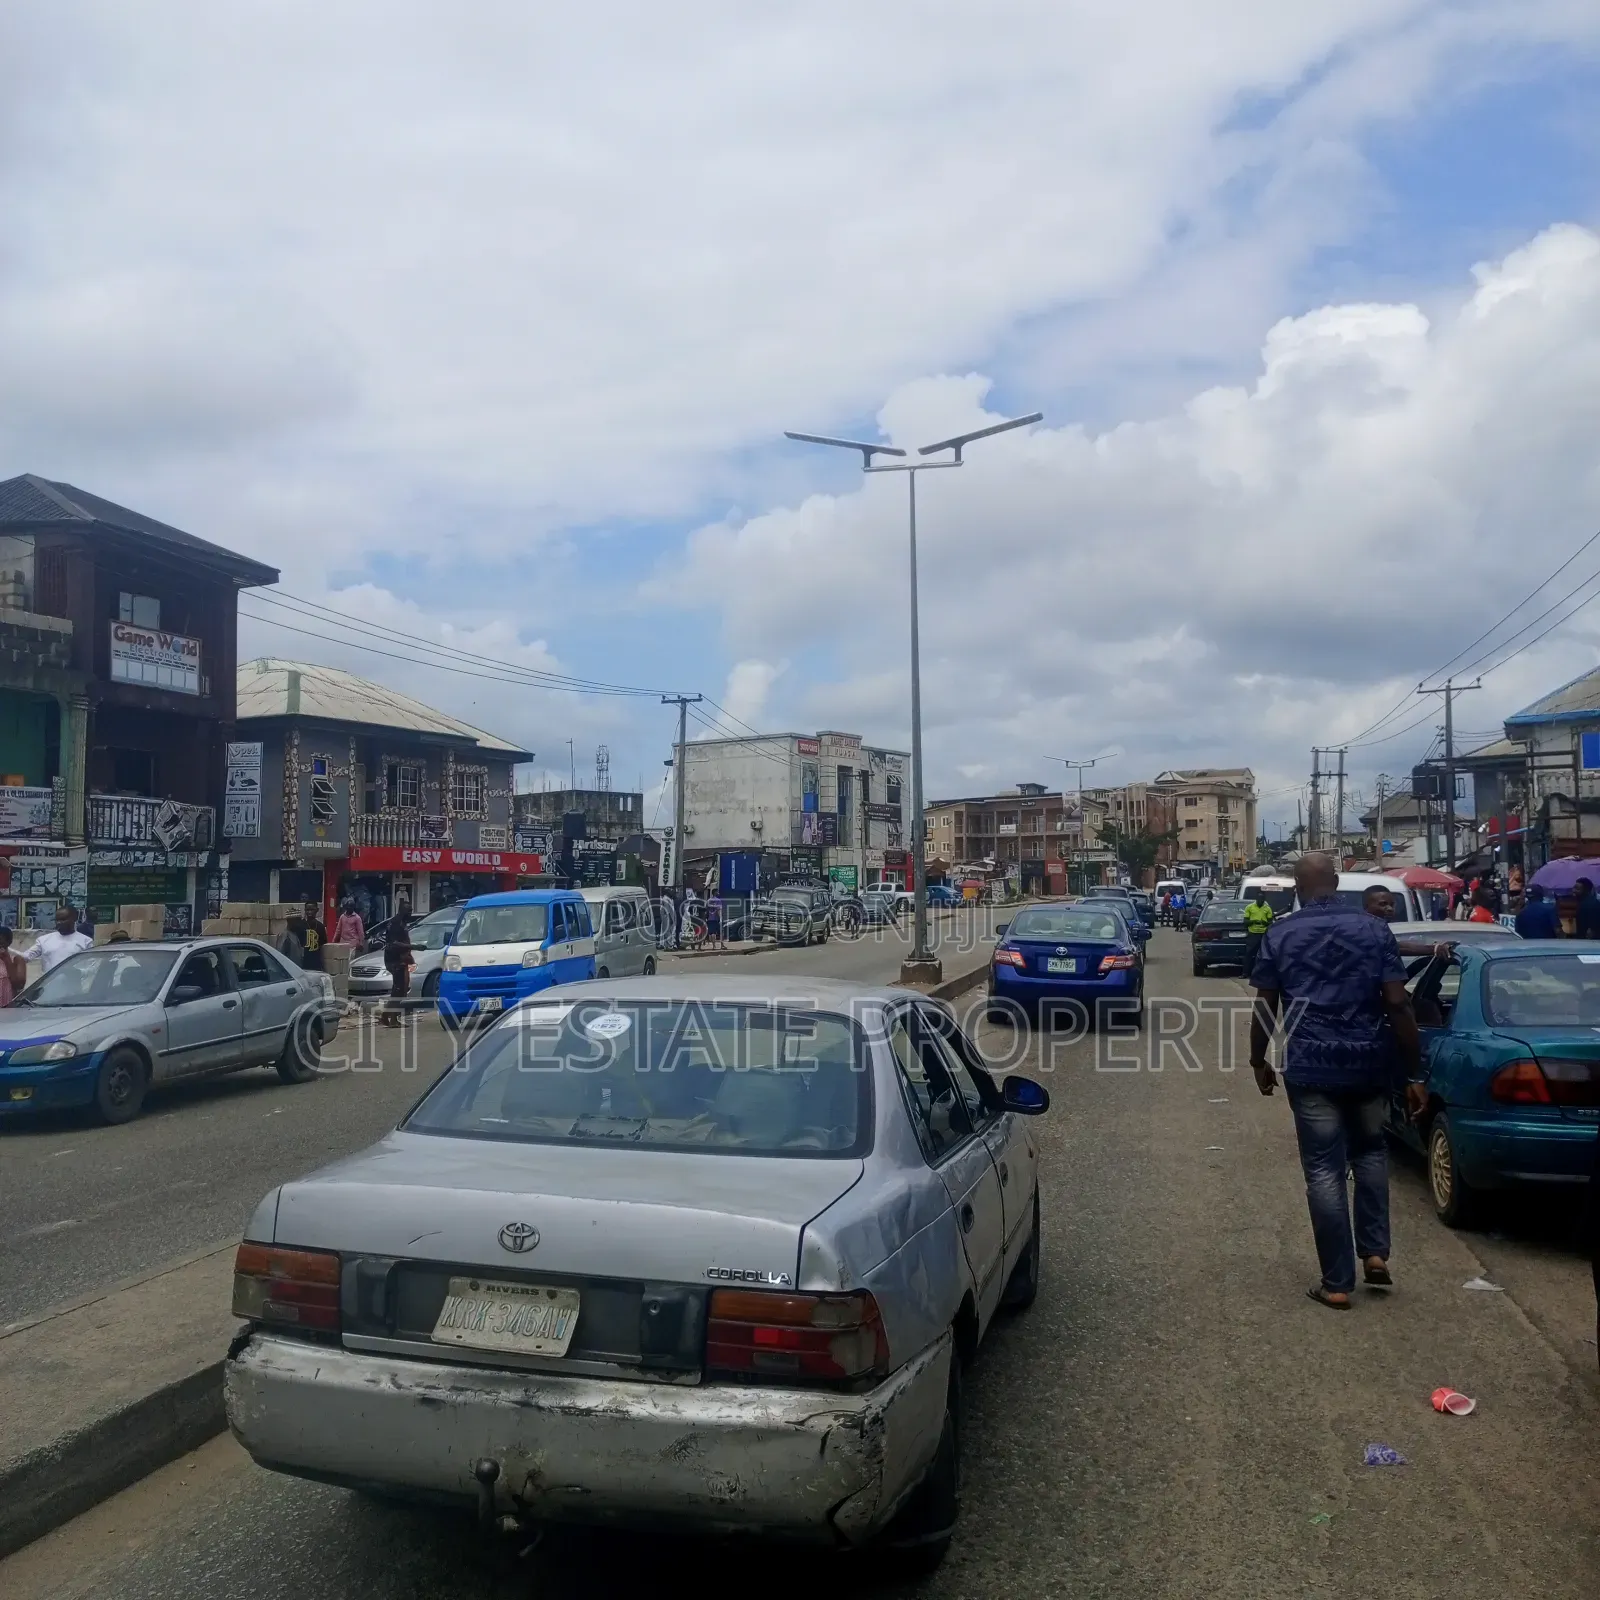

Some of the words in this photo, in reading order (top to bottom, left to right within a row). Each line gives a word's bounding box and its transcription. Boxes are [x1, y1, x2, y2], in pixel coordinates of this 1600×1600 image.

[114, 625, 154, 648] Game
[157, 633, 198, 657] World
[130, 644, 182, 661] Electronics
[402, 850, 442, 864] EASY
[452, 851, 501, 866] WORLD
[662, 842, 671, 886] PHARMACY
[706, 1266, 792, 1285] COROLLA
[486, 1284, 540, 1296] RIVERS
